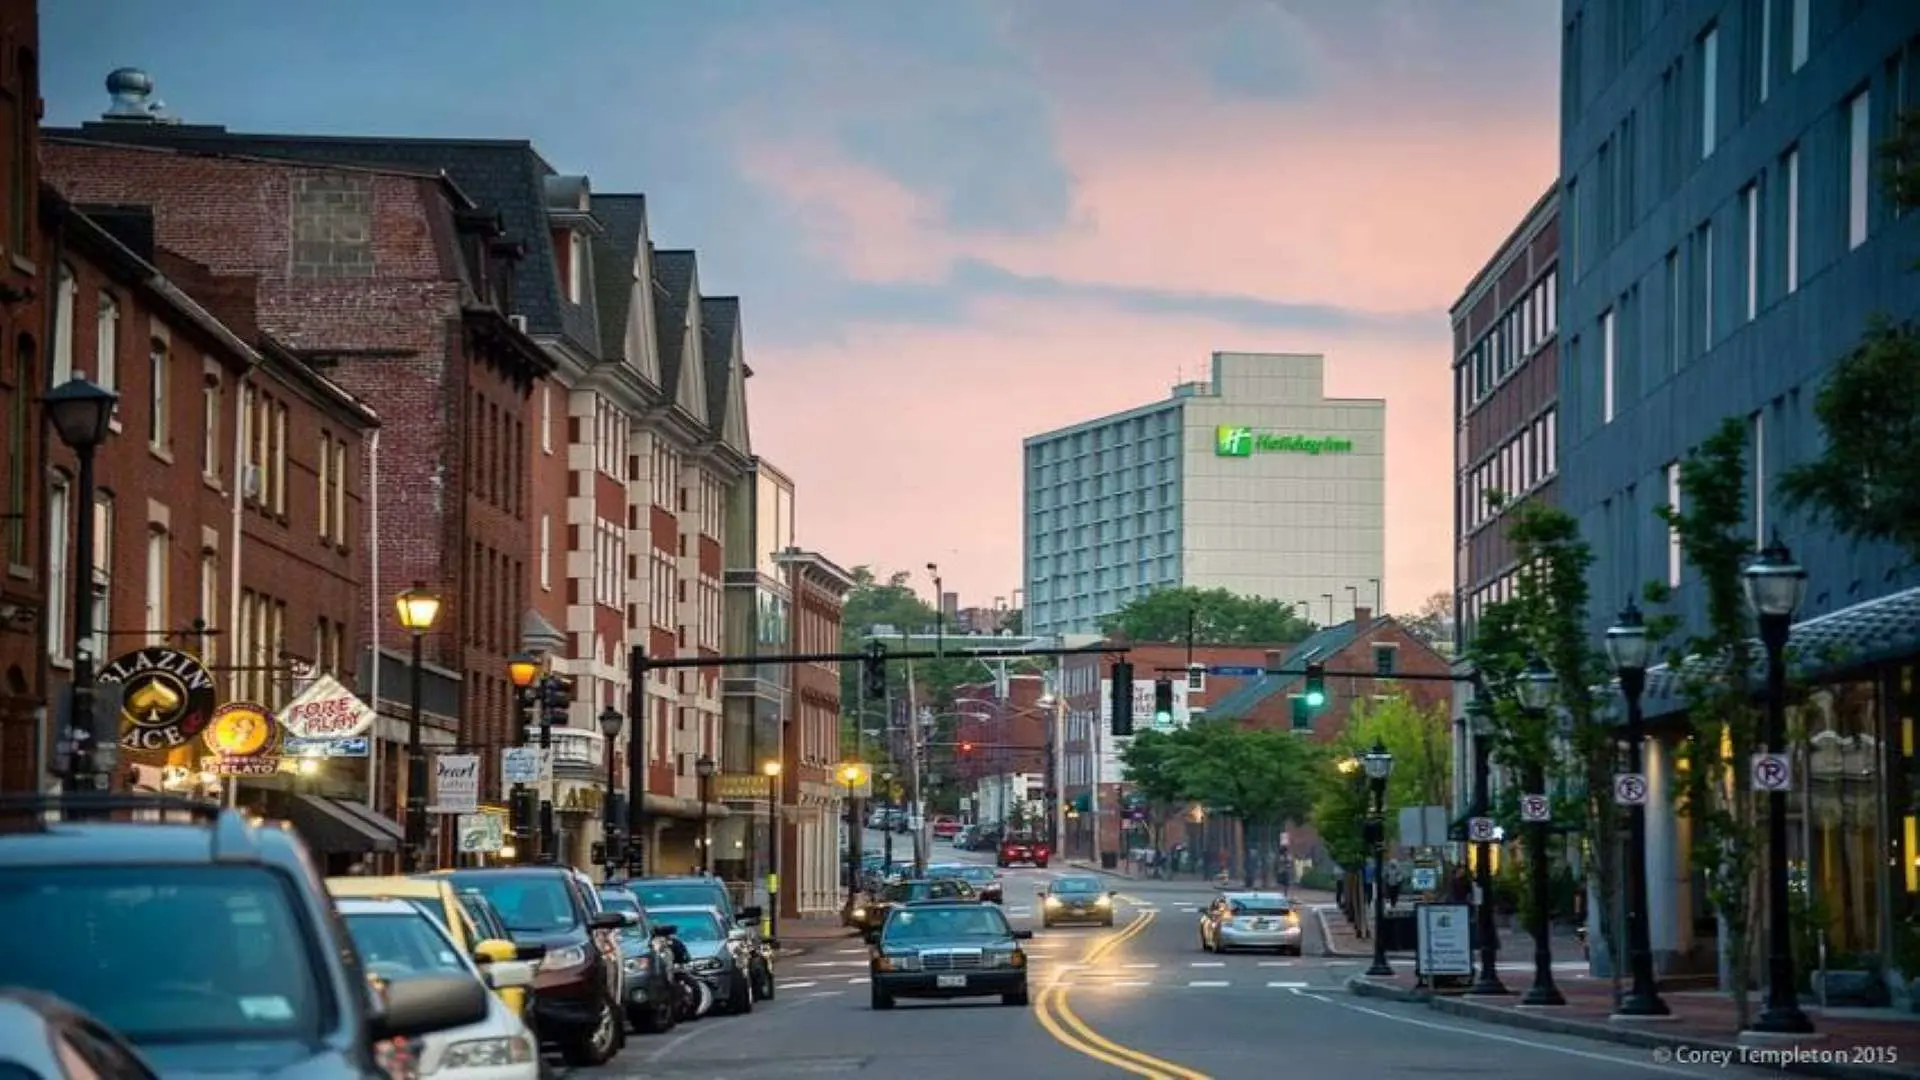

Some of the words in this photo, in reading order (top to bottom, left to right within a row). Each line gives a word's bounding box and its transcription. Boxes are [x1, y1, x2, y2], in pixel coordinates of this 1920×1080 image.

[289, 696, 352, 723] FORE
[306, 711, 361, 735] PLAY
[121, 724, 185, 750] ACE
